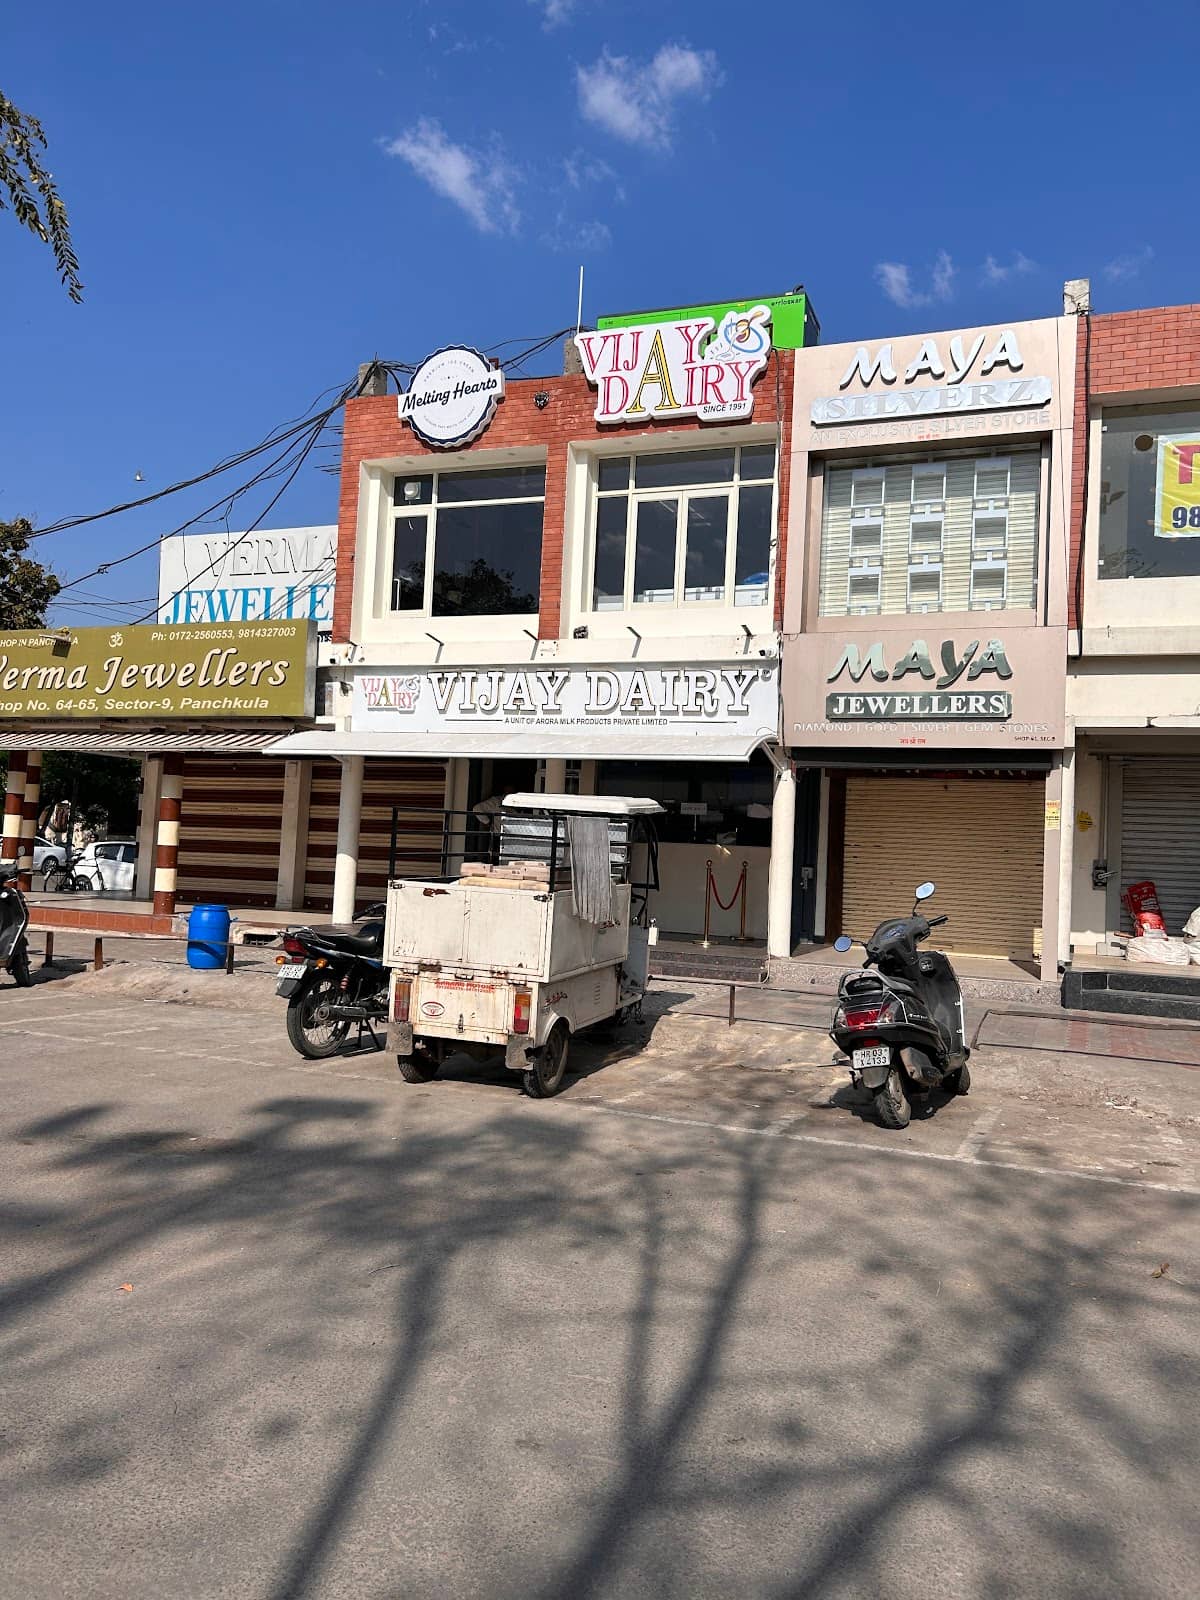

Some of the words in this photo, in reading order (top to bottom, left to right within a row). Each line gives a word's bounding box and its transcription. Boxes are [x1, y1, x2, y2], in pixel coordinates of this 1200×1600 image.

[580, 323, 709, 382] VIJAY
[840, 329, 1023, 388] MAYA
[402, 390, 451, 413] Melting
[453, 379, 498, 400] Hearts
[600, 355, 760, 415] DAIRY
[825, 380, 1034, 419] SILVERZ
[702, 404, 726, 414] SINCE
[729, 402, 747, 412] 1991
[991, 410, 1050, 428] STORE
[164, 583, 336, 624] JEWELLE
[95, 648, 290, 695] Jewellers
[827, 640, 1013, 689] MAYA
[26, 699, 51, 711] No.
[55, 698, 99, 712] 64-65,
[104, 697, 175, 711] Sector-9,
[180, 696, 269, 710] Panchkula
[427, 670, 571, 714] VIJAY
[585, 670, 759, 715] DAIRY
[832, 694, 1007, 716] JEWELLERS
